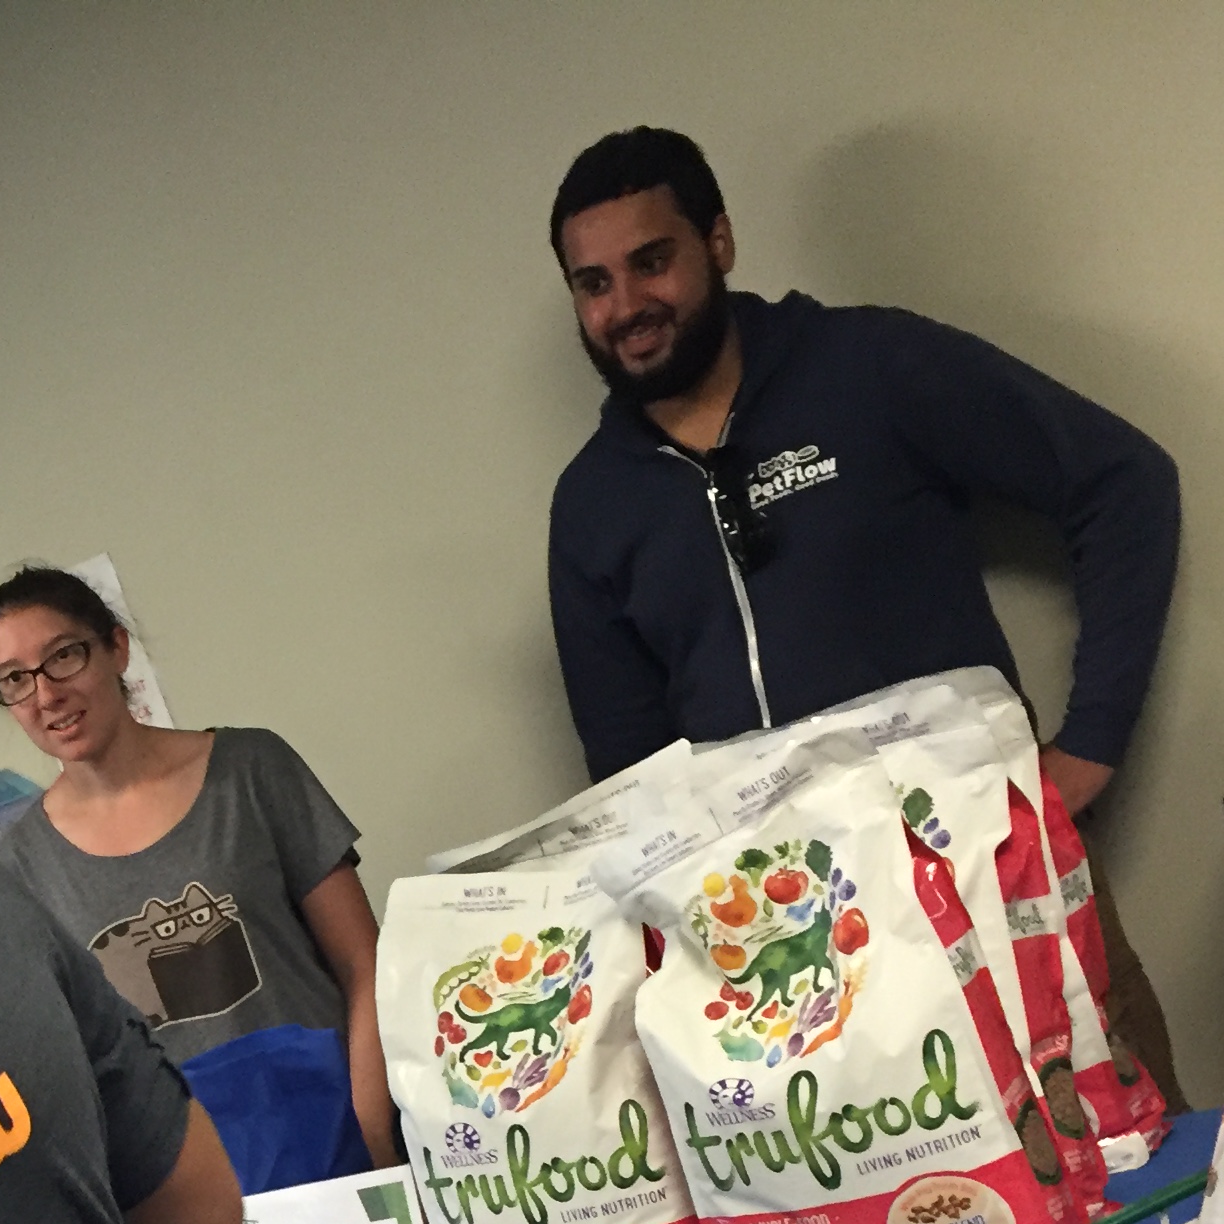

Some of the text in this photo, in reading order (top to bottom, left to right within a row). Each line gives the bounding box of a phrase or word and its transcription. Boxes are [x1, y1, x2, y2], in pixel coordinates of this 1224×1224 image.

[748, 457, 837, 503] PetFlow
[737, 765, 791, 801] WHAT'S OUT
[684, 1028, 978, 1191] trufood
[705, 1102, 776, 1128] WELLNESS
[440, 1149, 498, 1169] WELLNESS
[856, 1128, 982, 1177] LIVING NUTRITION
[560, 1187, 667, 1224] LIVING NUTRITION
